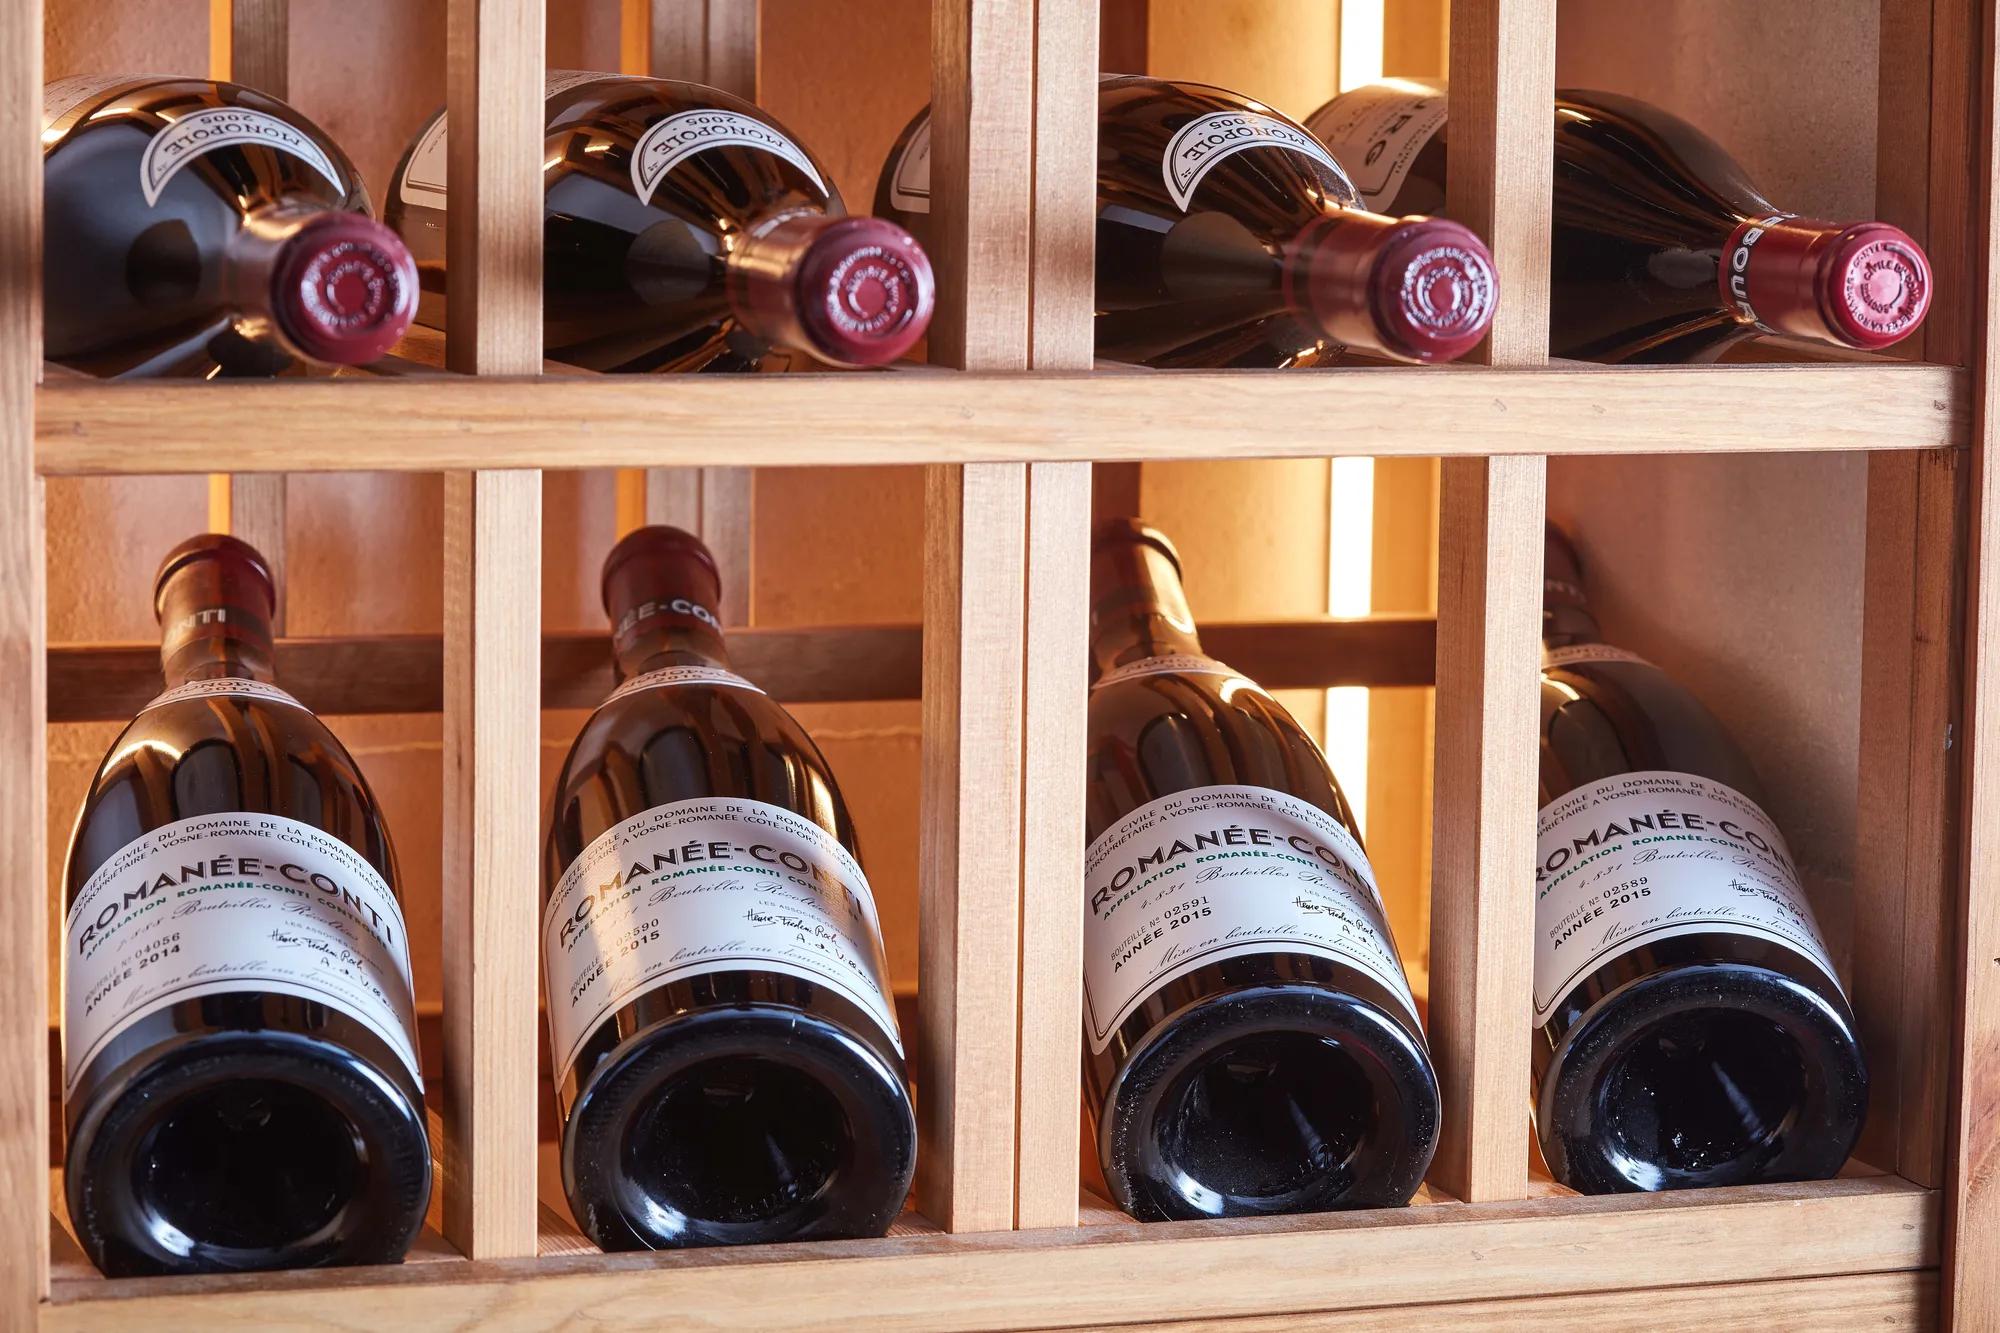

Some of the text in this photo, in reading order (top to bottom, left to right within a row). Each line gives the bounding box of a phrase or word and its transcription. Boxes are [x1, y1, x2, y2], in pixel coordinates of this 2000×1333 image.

[200, 113, 254, 125] 2005
[686, 115, 737, 126] 2005
[163, 122, 303, 157] MONOPOLE
[652, 125, 785, 156] MONOPOLE
[1182, 126, 1306, 161] MONOPOLE
[1552, 794, 1590, 817] CIVILE
[1596, 784, 1615, 796] DU
[1622, 778, 1683, 789] DOMAINE
[1689, 780, 1706, 790] DE
[1602, 786, 1703, 802] VOSNE-ROMANÉE
[622, 837, 631, 846] A
[632, 813, 739, 840] VOSNE-ROMANÉE
[627, 819, 647, 833] DU
[654, 805, 718, 821] DOMAINE
[726, 805, 744, 814] DE
[752, 808, 768, 818] LA
[1121, 809, 1157, 834] CIVILE
[1164, 800, 1182, 811] DU
[1191, 792, 1253, 804] DOMAINE
[1261, 794, 1277, 804] DE
[1285, 801, 1299, 811] LA
[113, 841, 151, 868] CIVILE
[157, 829, 177, 843] DU
[185, 819, 251, 833] DOMAINE
[260, 821, 278, 831] DE
[286, 826, 303, 837] LA
[150, 846, 159, 855] A
[162, 829, 272, 850] VOSNE-ROMANÉE
[1090, 820, 1158, 873] PROPRIÉTAIRE
[1159, 815, 1168, 823] A
[1170, 801, 1274, 818] VOSNE-ROMANÉE
[1539, 834, 1751, 901] APPELLATION ROMANÉE-CONTI
[1632, 847, 1724, 866] Bouteilles
[1103, 862, 1187, 921] APPELLATION
[1195, 849, 1320, 870] ROMANÉE-CONTI
[1195, 865, 1290, 885] Bouteilles
[79, 854, 394, 956] ROMANÉE-CONTI
[171, 896, 272, 920] Bouteilles
[567, 885, 643, 955] APPELLATION
[651, 864, 781, 885] ROMANÉE-CONTI
[647, 880, 745, 907] Bouteilles
[1549, 903, 1586, 939] BOUTEILLE
[1603, 876, 1649, 900] 02589
[84, 896, 167, 961] APPELLATION
[177, 880, 310, 899] ROMANÉE-CONTI
[615, 917, 660, 947] 02590
[1109, 925, 1147, 961] BOUTEILLE
[1163, 895, 1210, 920] 02591
[1199, 936, 1220, 948] en
[1225, 924, 1298, 941] bouteille
[1554, 887, 1652, 951] ANNÉE 2015
[1591, 921, 1638, 952] Mise
[1641, 917, 1661, 926] en
[1666, 905, 1736, 919] bouteille
[134, 931, 181, 959] 04056
[669, 940, 747, 962] bouteille
[1114, 906, 1213, 973] ANNÉE 2015
[84, 944, 181, 1018] ANNÉE 2014
[571, 958, 615, 1008] ANNÉE
[620, 929, 661, 958] 2015
